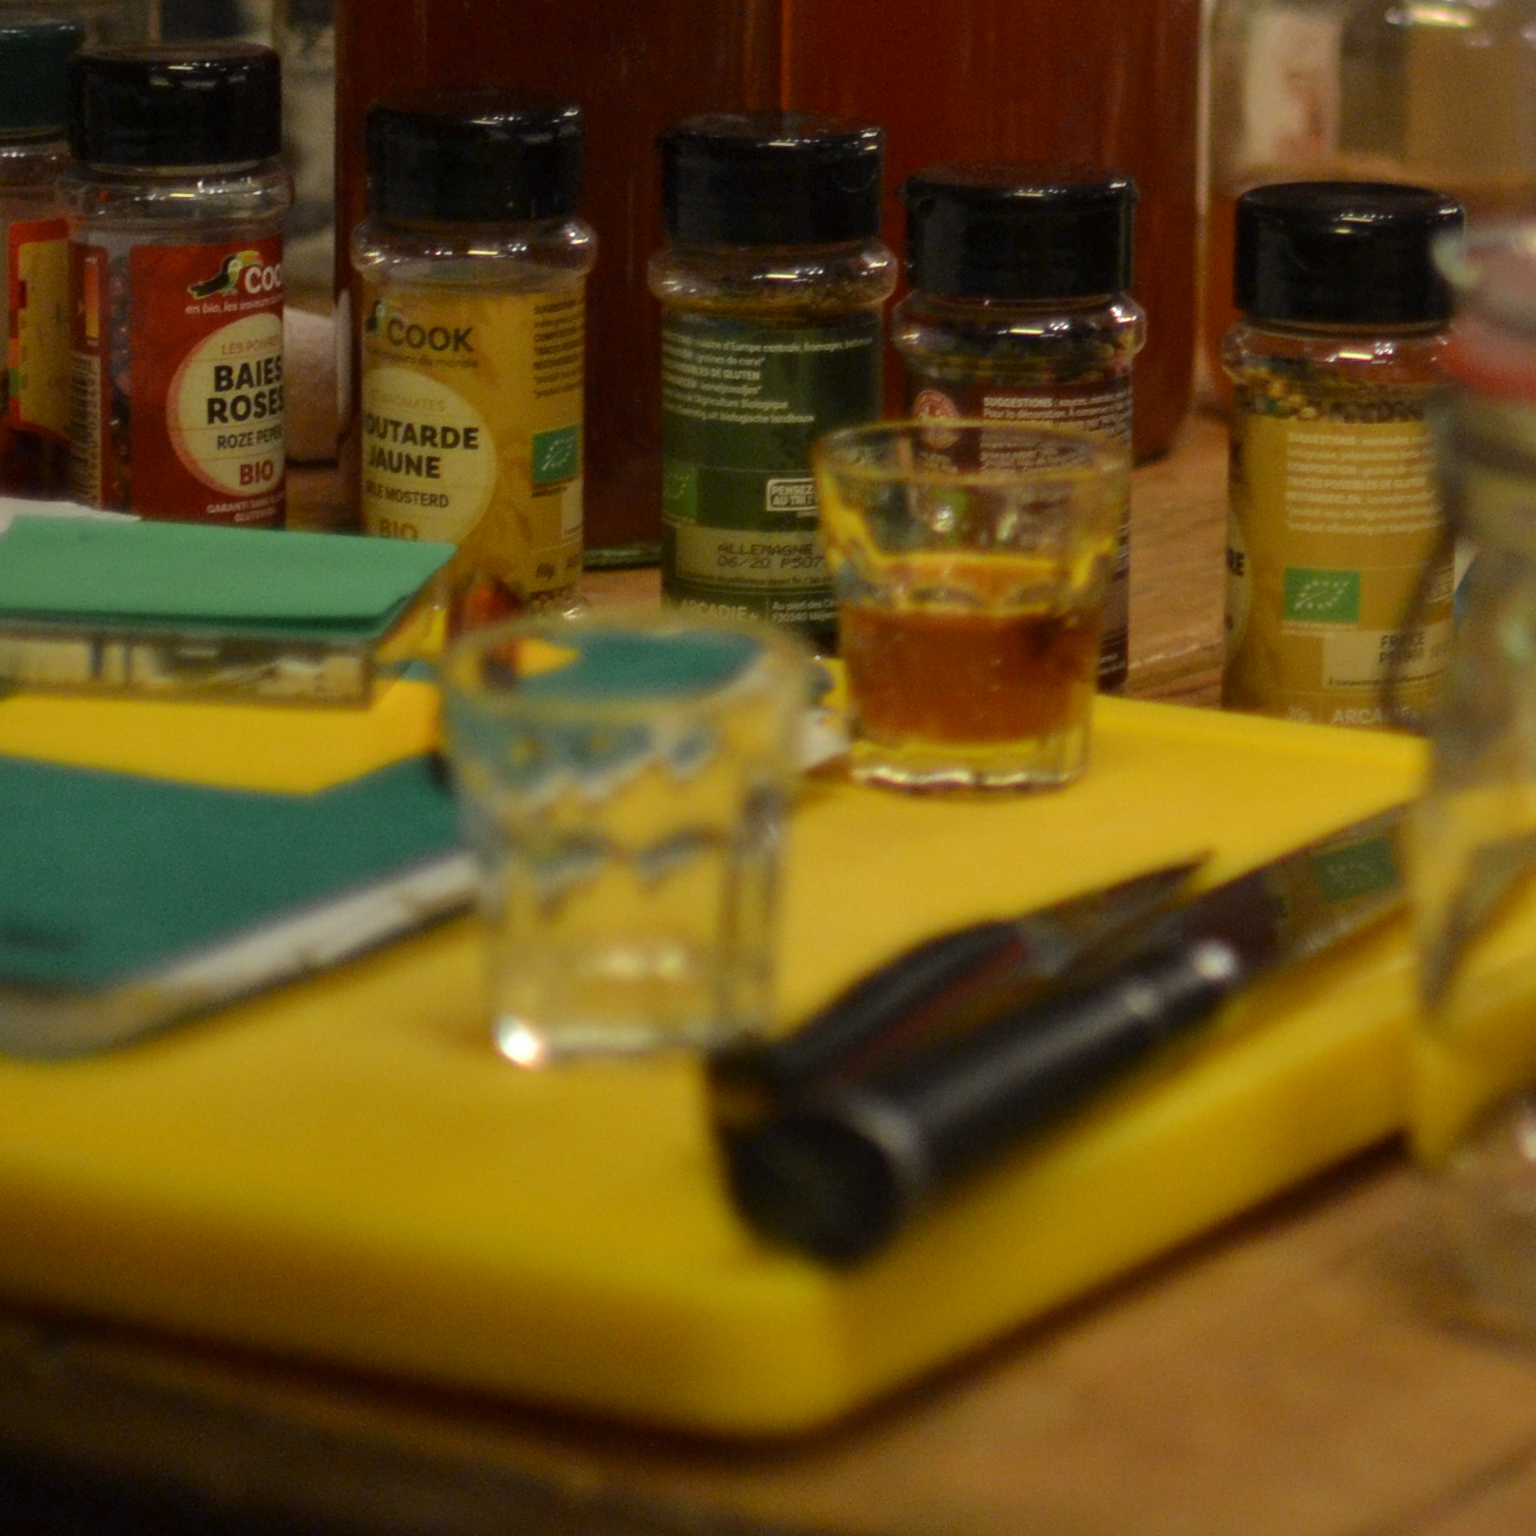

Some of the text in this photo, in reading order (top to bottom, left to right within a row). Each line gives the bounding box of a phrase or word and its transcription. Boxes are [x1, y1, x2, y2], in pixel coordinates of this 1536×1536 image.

[244, 263, 283, 295] COO
[387, 318, 475, 353] COOK
[213, 354, 283, 393] BAIES
[206, 385, 285, 426] ROSES
[216, 431, 254, 450] ROZE
[365, 412, 479, 450] OUTARDE
[239, 459, 274, 486] BIO
[384, 486, 450, 509] MOSTERD
[771, 484, 815, 496] PENSEZ
[773, 494, 787, 506] AU
[717, 544, 814, 558] ALLEMAGNE
[717, 554, 771, 569] 06/20
